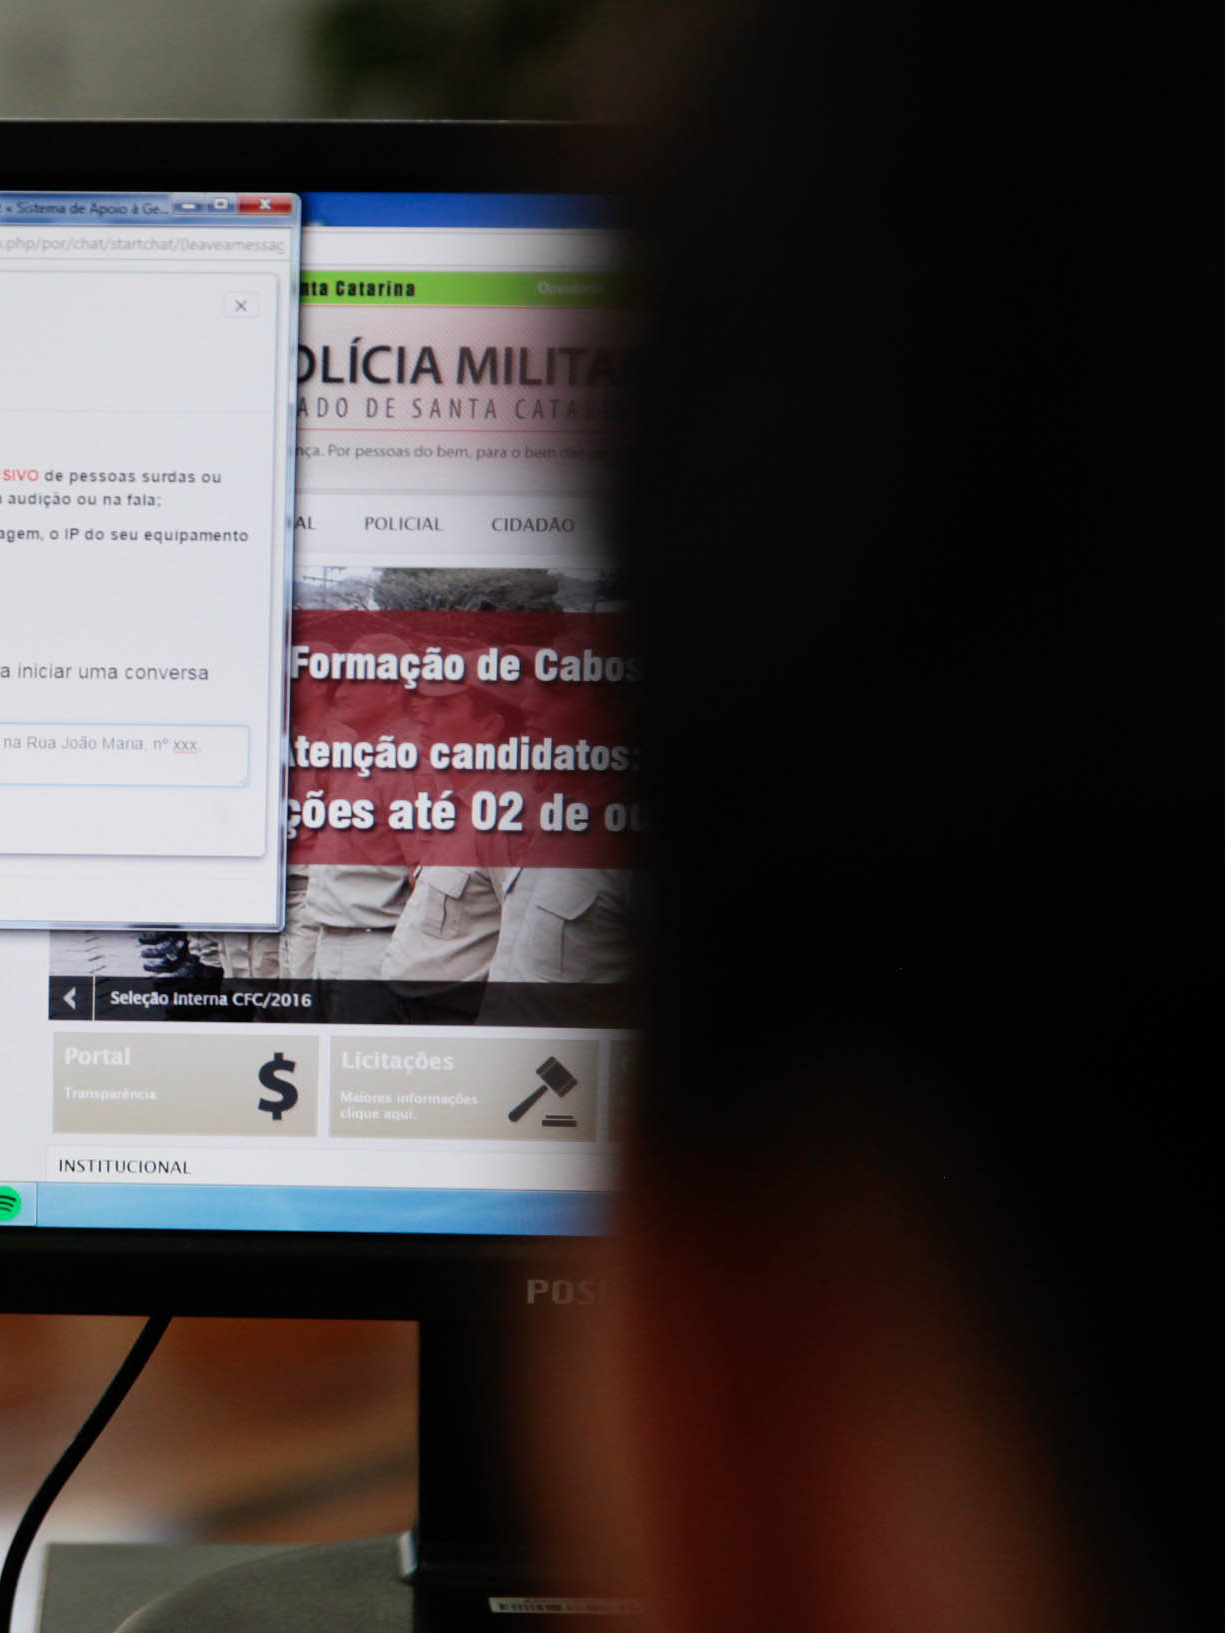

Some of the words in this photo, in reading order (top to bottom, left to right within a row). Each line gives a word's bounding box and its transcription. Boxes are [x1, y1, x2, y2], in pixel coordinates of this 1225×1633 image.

[16, 201, 64, 217] Sistema
[69, 202, 86, 217] de
[91, 202, 125, 219] Apoio
[336, 281, 415, 296] Catarina
[456, 347, 617, 386] MILITA
[367, 397, 395, 418] DE
[411, 397, 497, 419] SANTA
[327, 443, 351, 457] Por
[355, 446, 410, 461] pessoas
[415, 444, 433, 458] do
[437, 445, 471, 460] bem,
[476, 447, 507, 462] para
[511, 448, 521, 459] o
[525, 445, 557, 459] bem
[44, 469, 63, 484] de
[69, 472, 136, 488] pessoas
[141, 469, 195, 484] surdas
[201, 472, 221, 484] ou
[8, 490, 71, 509] audição
[77, 494, 97, 506] ou
[102, 494, 121, 506] na
[126, 491, 161, 508] fala;
[364, 516, 442, 531] POLICIAL
[491, 514, 575, 532] CIDADÃO
[49, 530, 59, 541] o
[64, 527, 79, 541] IP
[85, 527, 105, 542] do
[110, 530, 139, 542] seu
[144, 528, 249, 546] equipamento
[17, 660, 72, 680] iniciar
[78, 665, 119, 681] uma
[125, 665, 209, 681] conversa
[291, 645, 465, 690] Formação
[477, 648, 521, 682] de
[534, 649, 642, 683] Cabos
[3, 738, 21, 750] na
[27, 735, 55, 751] Rua
[61, 733, 96, 752] João
[102, 736, 149, 753] Maria,
[388, 790, 456, 830] até
[472, 792, 523, 831] 02
[539, 794, 589, 831] de
[110, 990, 168, 1009] Seleção
[173, 991, 227, 1007] Interna
[232, 991, 312, 1009] CFC/2016
[64, 1048, 131, 1066] Portal
[341, 1051, 455, 1074] Licitações
[63, 1087, 157, 1102] Transparência
[340, 1091, 391, 1104] Maiores
[397, 1093, 478, 1107] informações
[340, 1107, 380, 1120] clique
[383, 1109, 416, 1121] aqui.
[58, 1159, 191, 1175] INSTITUCIONAL
